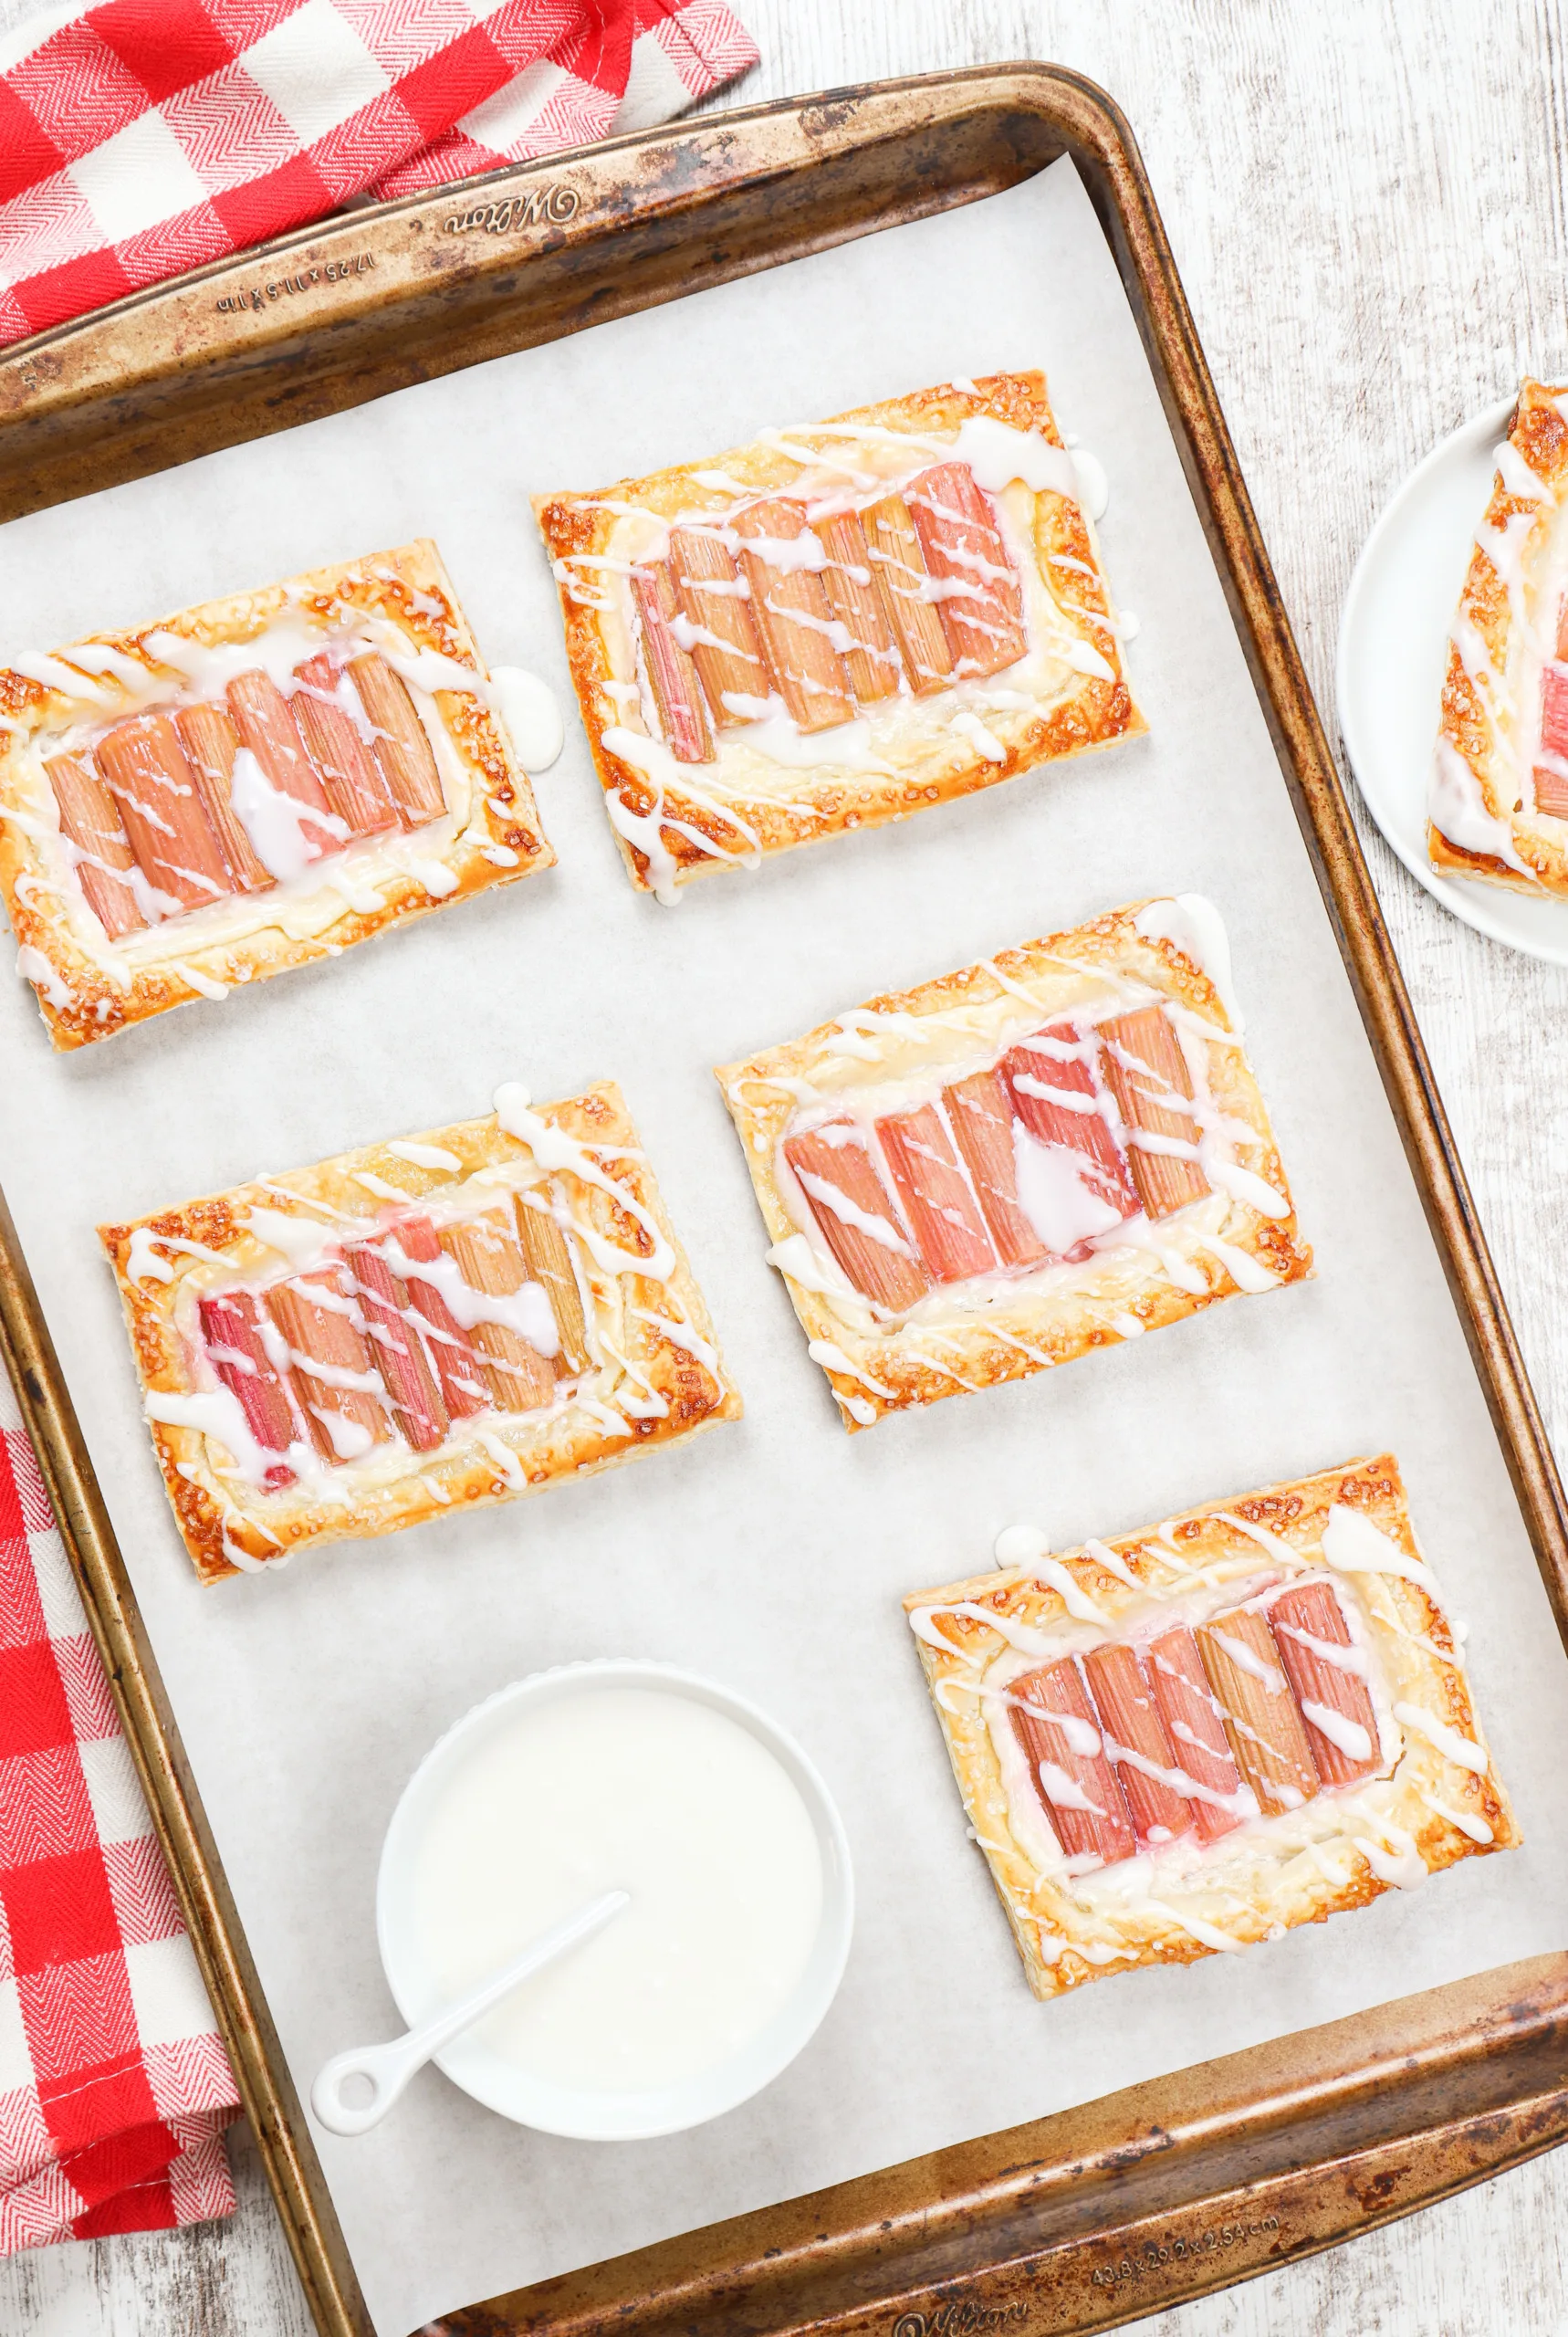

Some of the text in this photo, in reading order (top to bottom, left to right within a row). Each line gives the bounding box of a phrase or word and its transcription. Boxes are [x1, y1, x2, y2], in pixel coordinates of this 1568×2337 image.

[444, 183, 580, 235] Wilton
[309, 269, 320, 282] x
[326, 252, 376, 283] 17.25
[251, 288, 263, 301] x
[266, 276, 306, 301] 11.5
[1092, 2216, 1280, 2286] 43.8 x 29.2 x 2.54 cm
[894, 2301, 1029, 2337] Wilton
